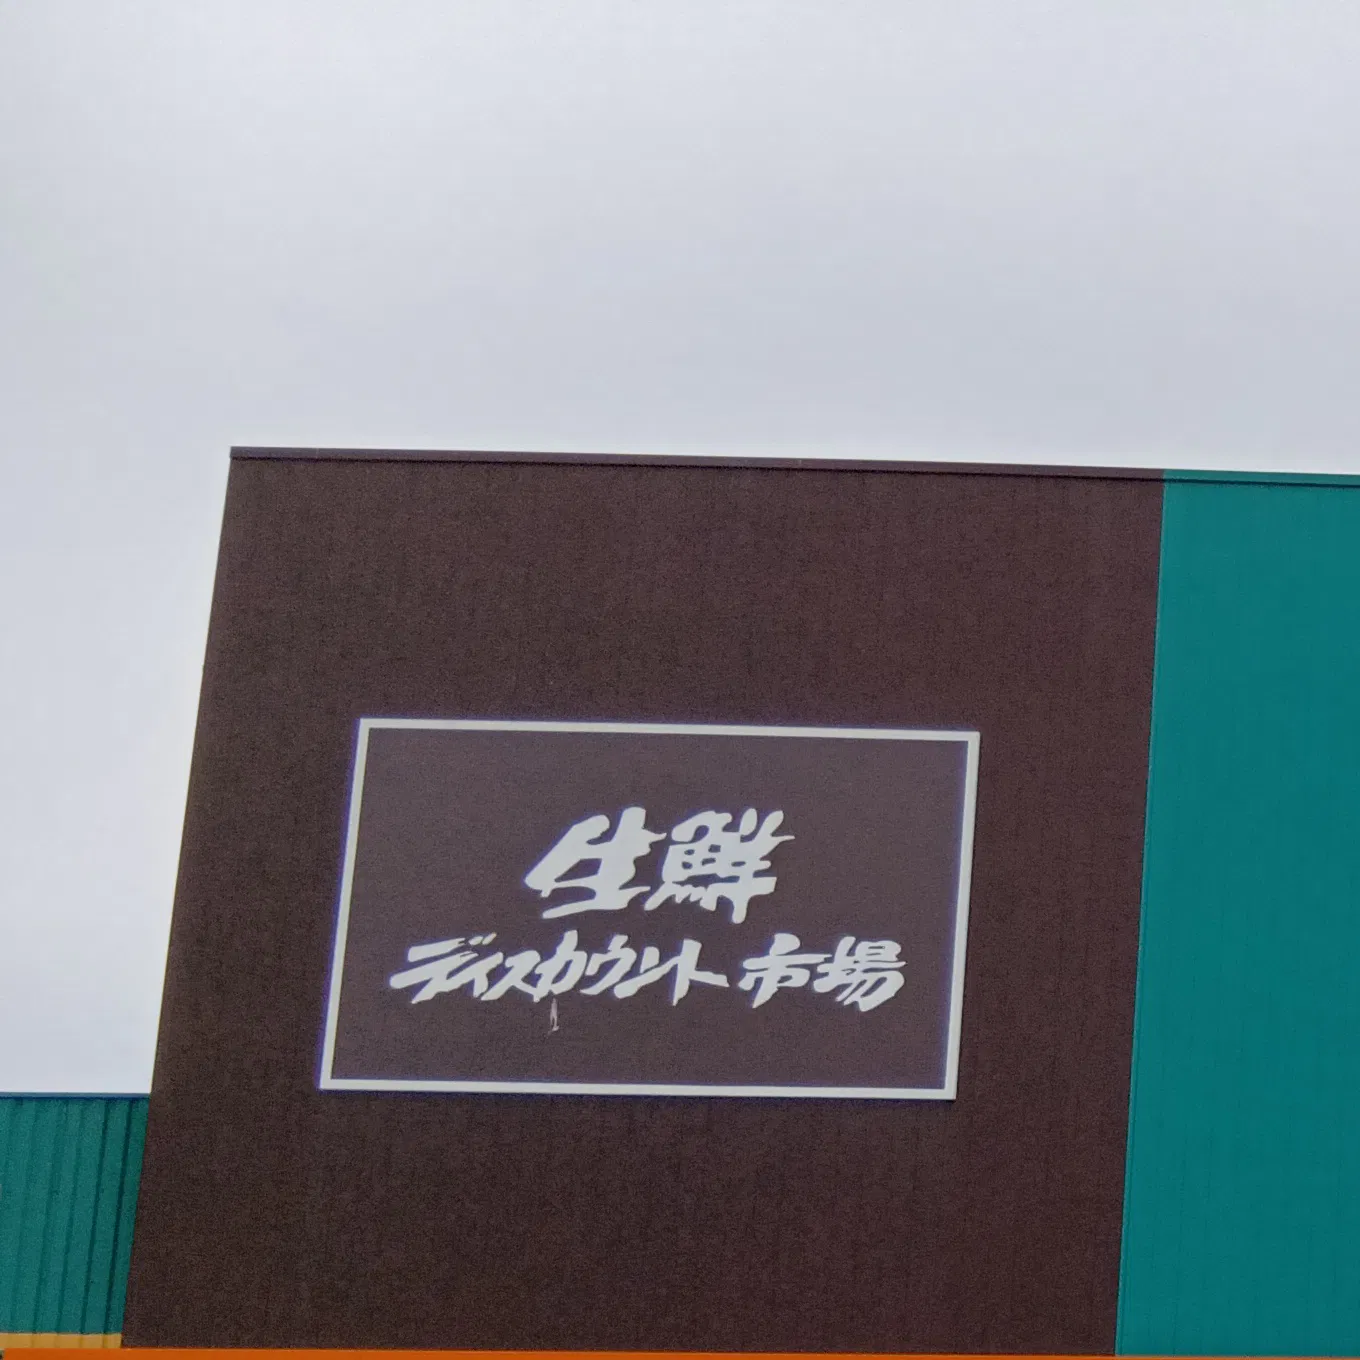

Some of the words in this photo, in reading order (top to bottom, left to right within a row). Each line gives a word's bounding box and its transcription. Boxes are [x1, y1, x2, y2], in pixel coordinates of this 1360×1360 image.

[524, 806, 796, 923] 生鮮
[389, 930, 730, 1006] ディスカウント
[738, 932, 907, 1012] 市場
